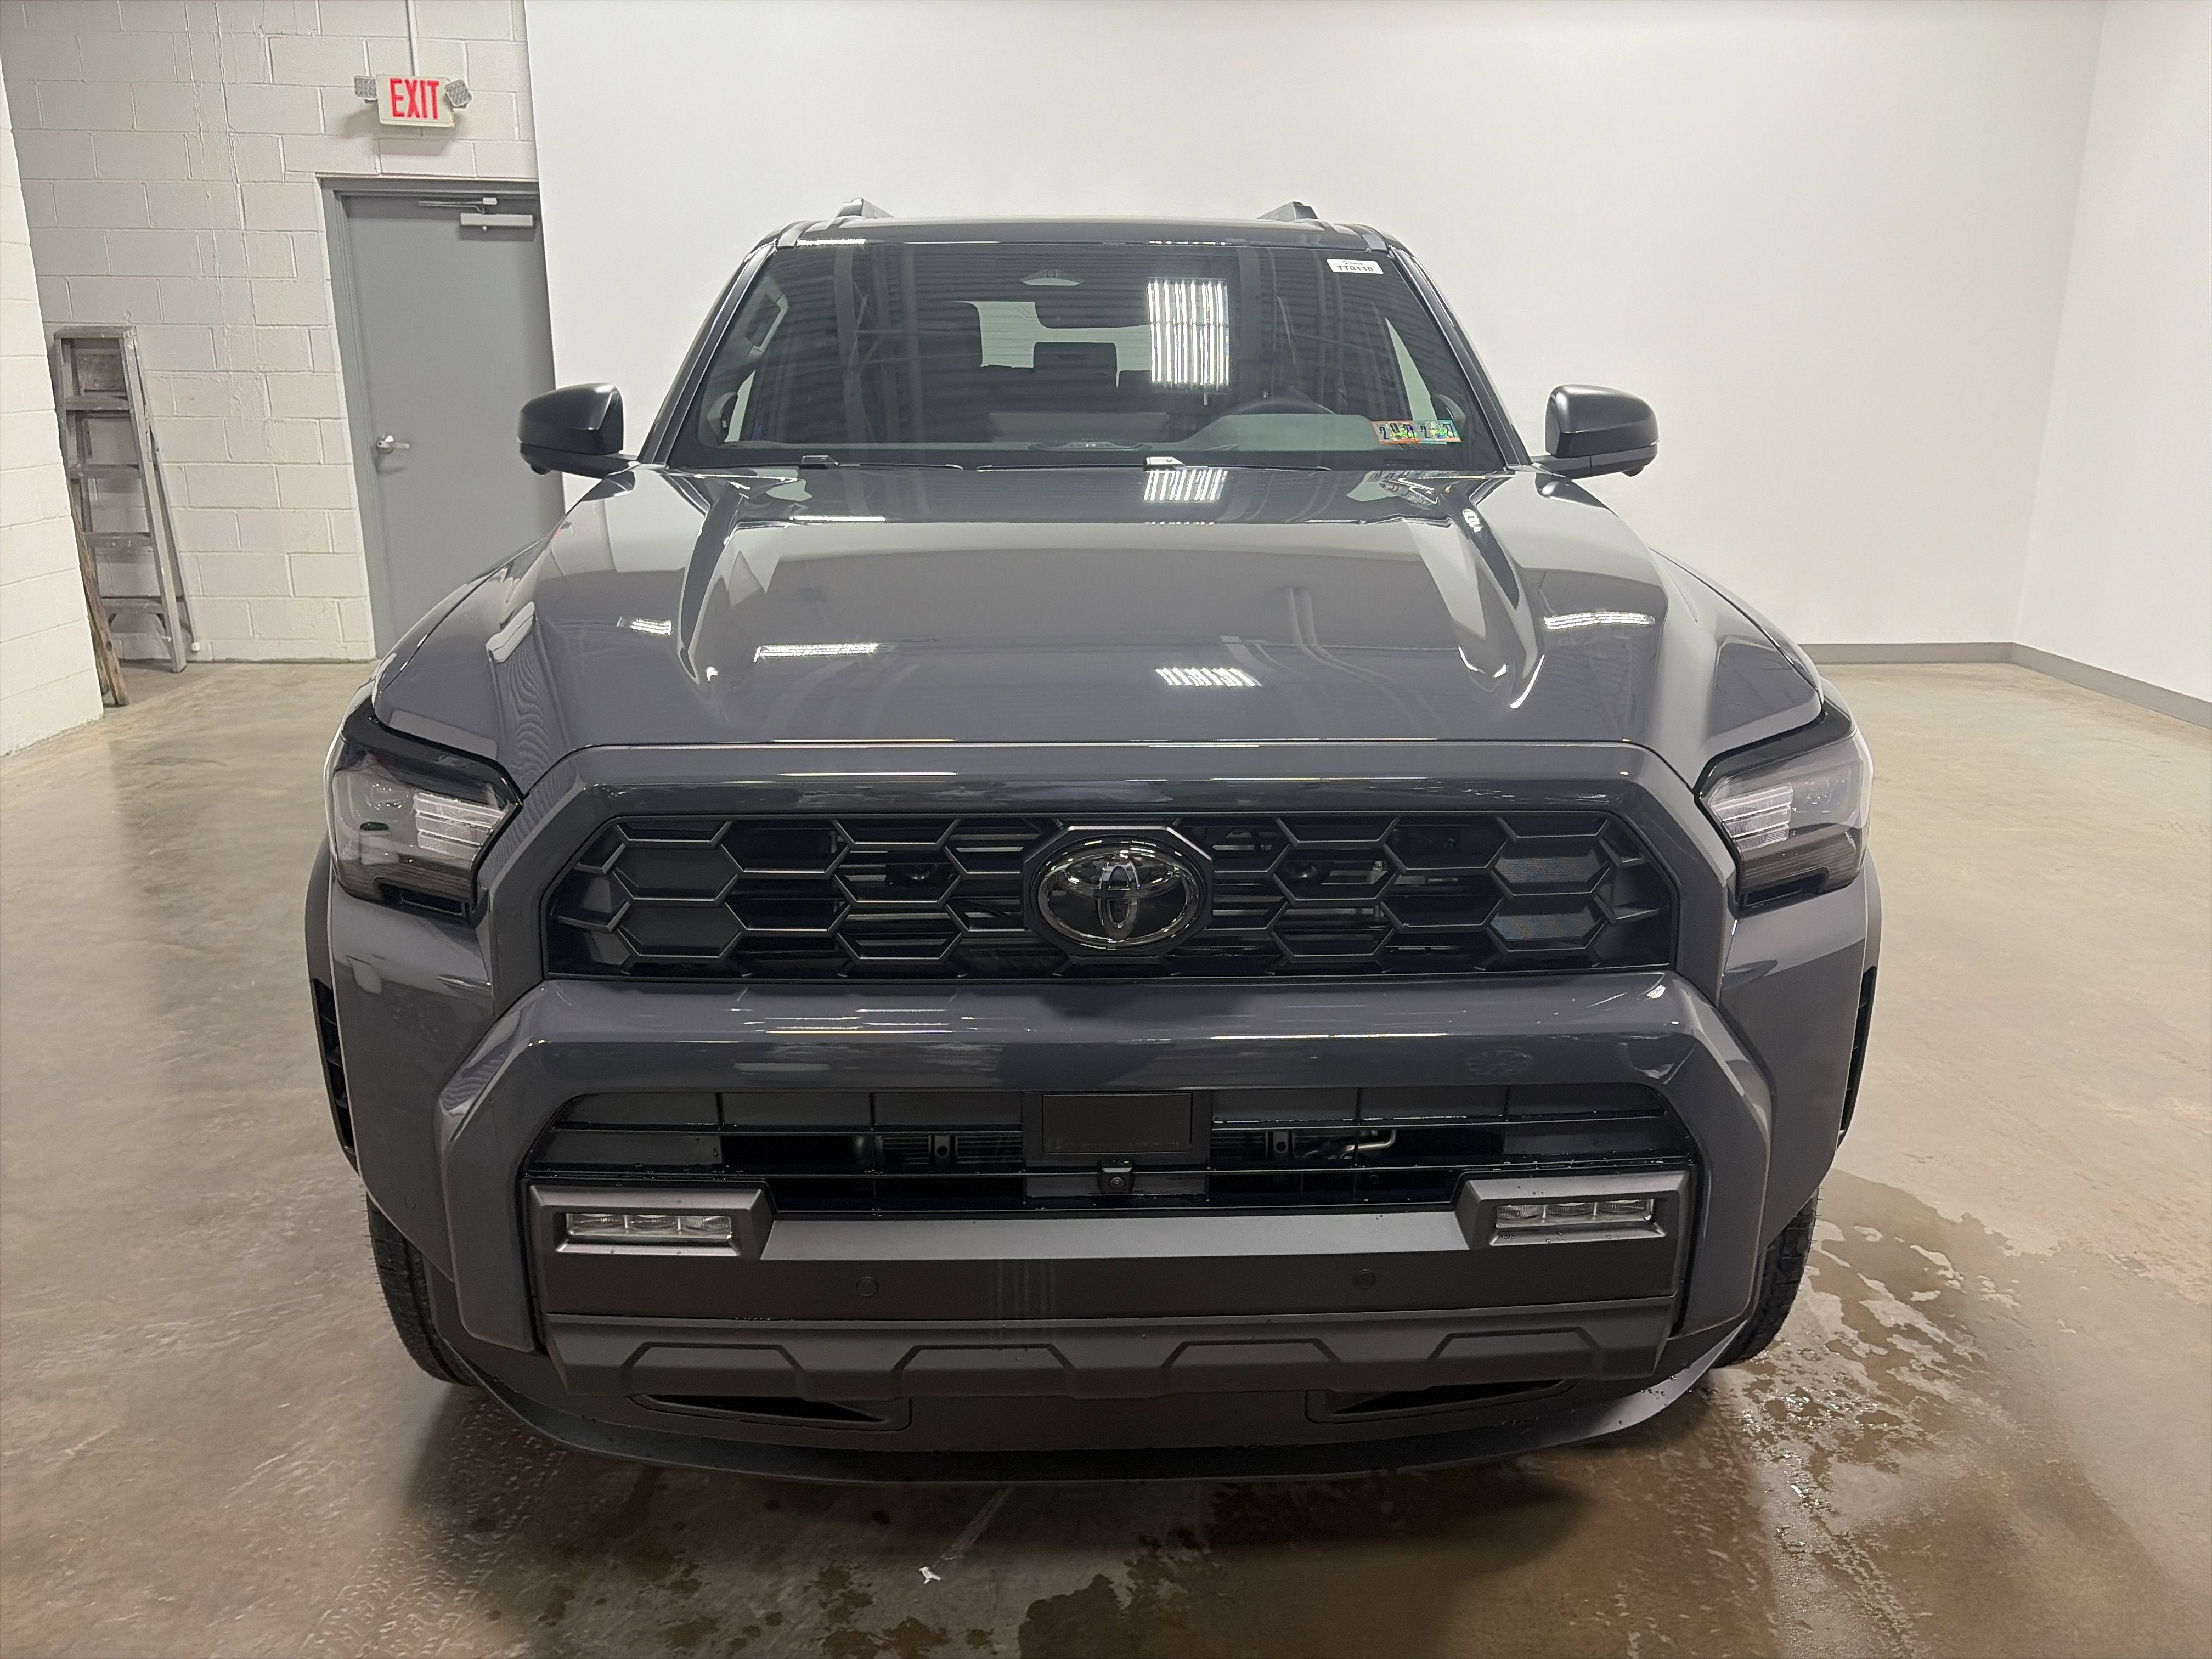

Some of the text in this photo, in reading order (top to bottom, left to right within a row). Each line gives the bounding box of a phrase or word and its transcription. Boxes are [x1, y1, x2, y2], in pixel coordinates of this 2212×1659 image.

[390, 78, 439, 120] EXIT
[1379, 427, 1389, 440] 2
[1420, 425, 1430, 438] 2
